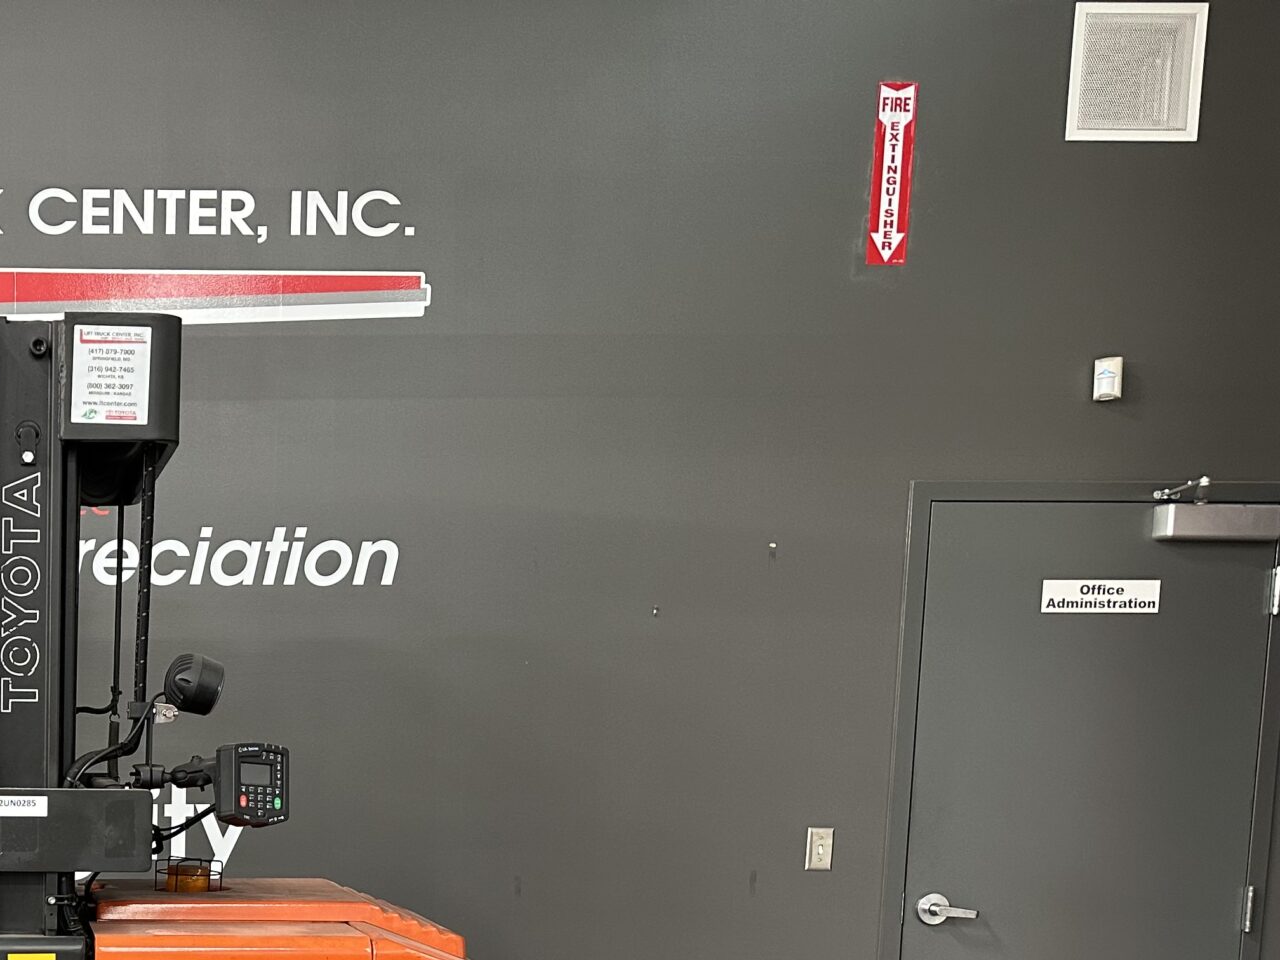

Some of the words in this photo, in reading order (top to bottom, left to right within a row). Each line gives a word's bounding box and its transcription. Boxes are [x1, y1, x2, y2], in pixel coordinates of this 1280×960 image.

[882, 97, 911, 112] FIRE
[881, 122, 900, 250] EXTINGUISHER
[28, 188, 267, 244] CENTER,
[290, 190, 416, 238] INC.
[79, 527, 399, 586] reciation
[0, 472, 41, 712] TOYOTA
[1046, 598, 1156, 608] Administration
[1080, 584, 1124, 595] Office
